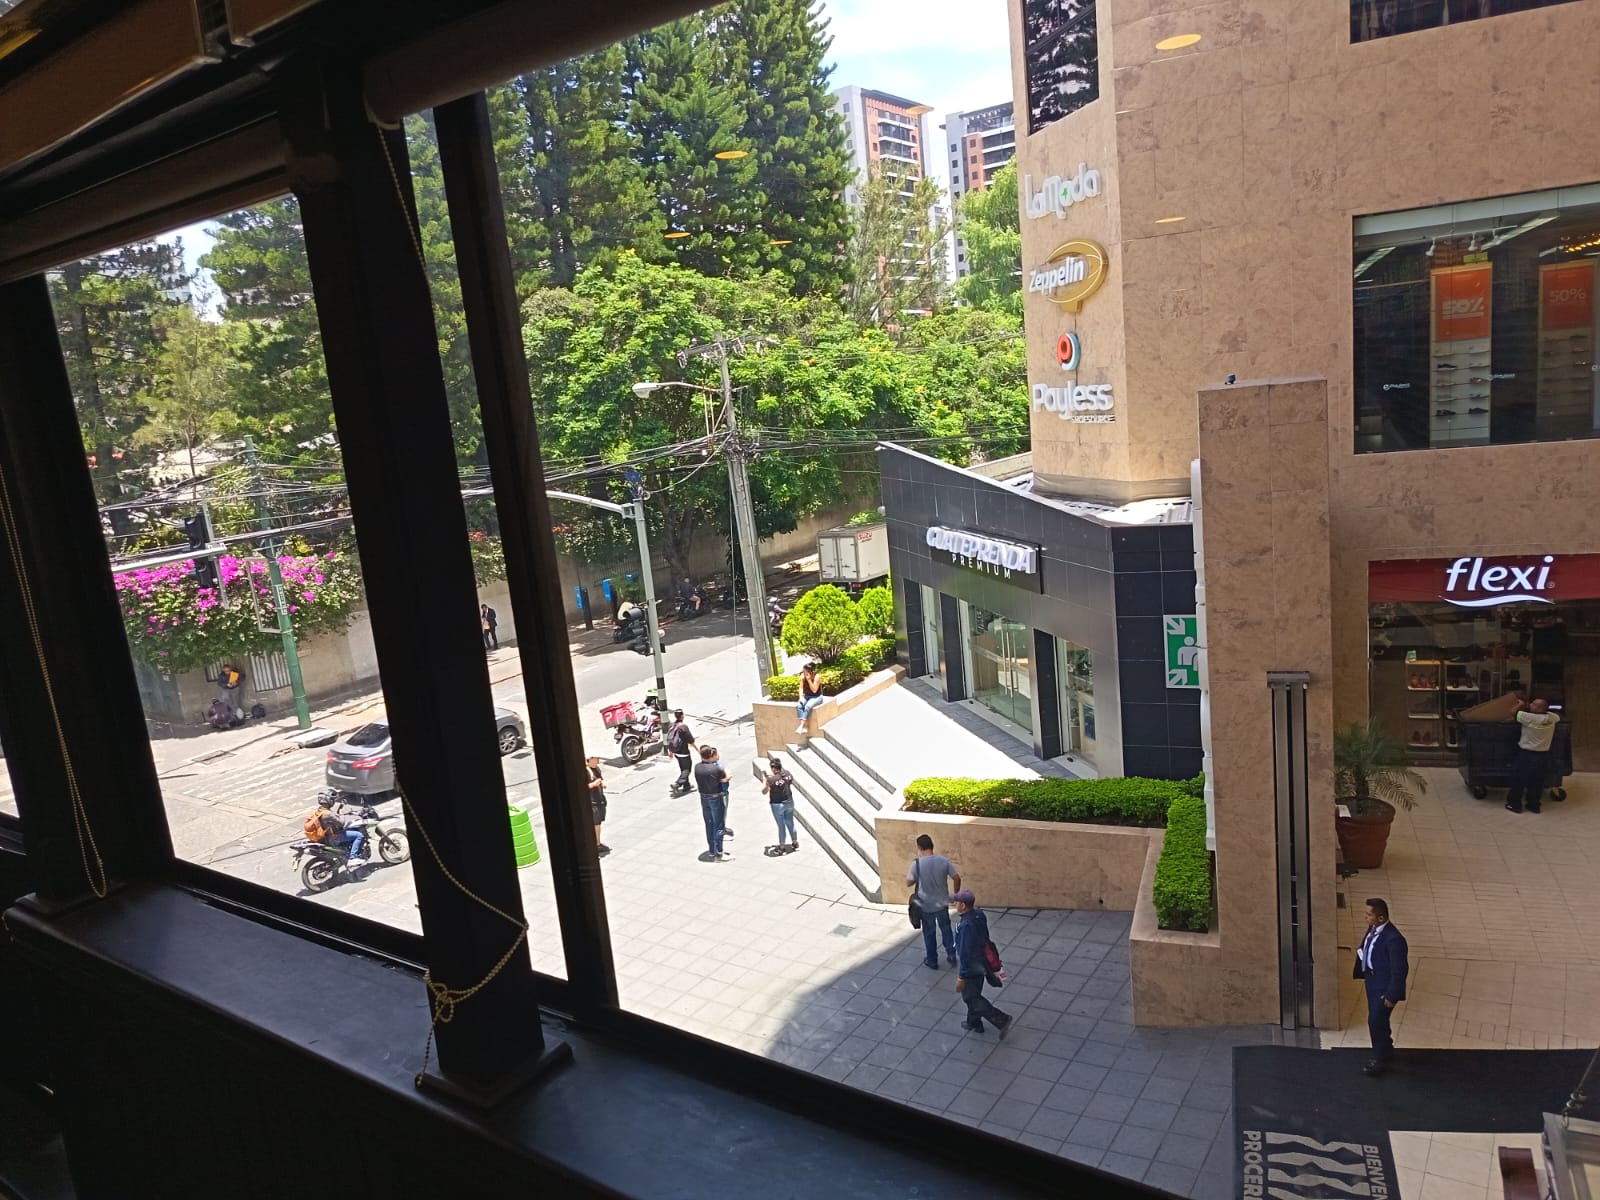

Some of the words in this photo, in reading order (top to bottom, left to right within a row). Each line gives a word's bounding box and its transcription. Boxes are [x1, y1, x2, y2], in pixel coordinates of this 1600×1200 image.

[1029, 256, 1085, 296] Zeppelin
[1032, 380, 1114, 420] Payless
[952, 553, 1011, 580] PREMIUM
[1446, 556, 1554, 592] flexi
